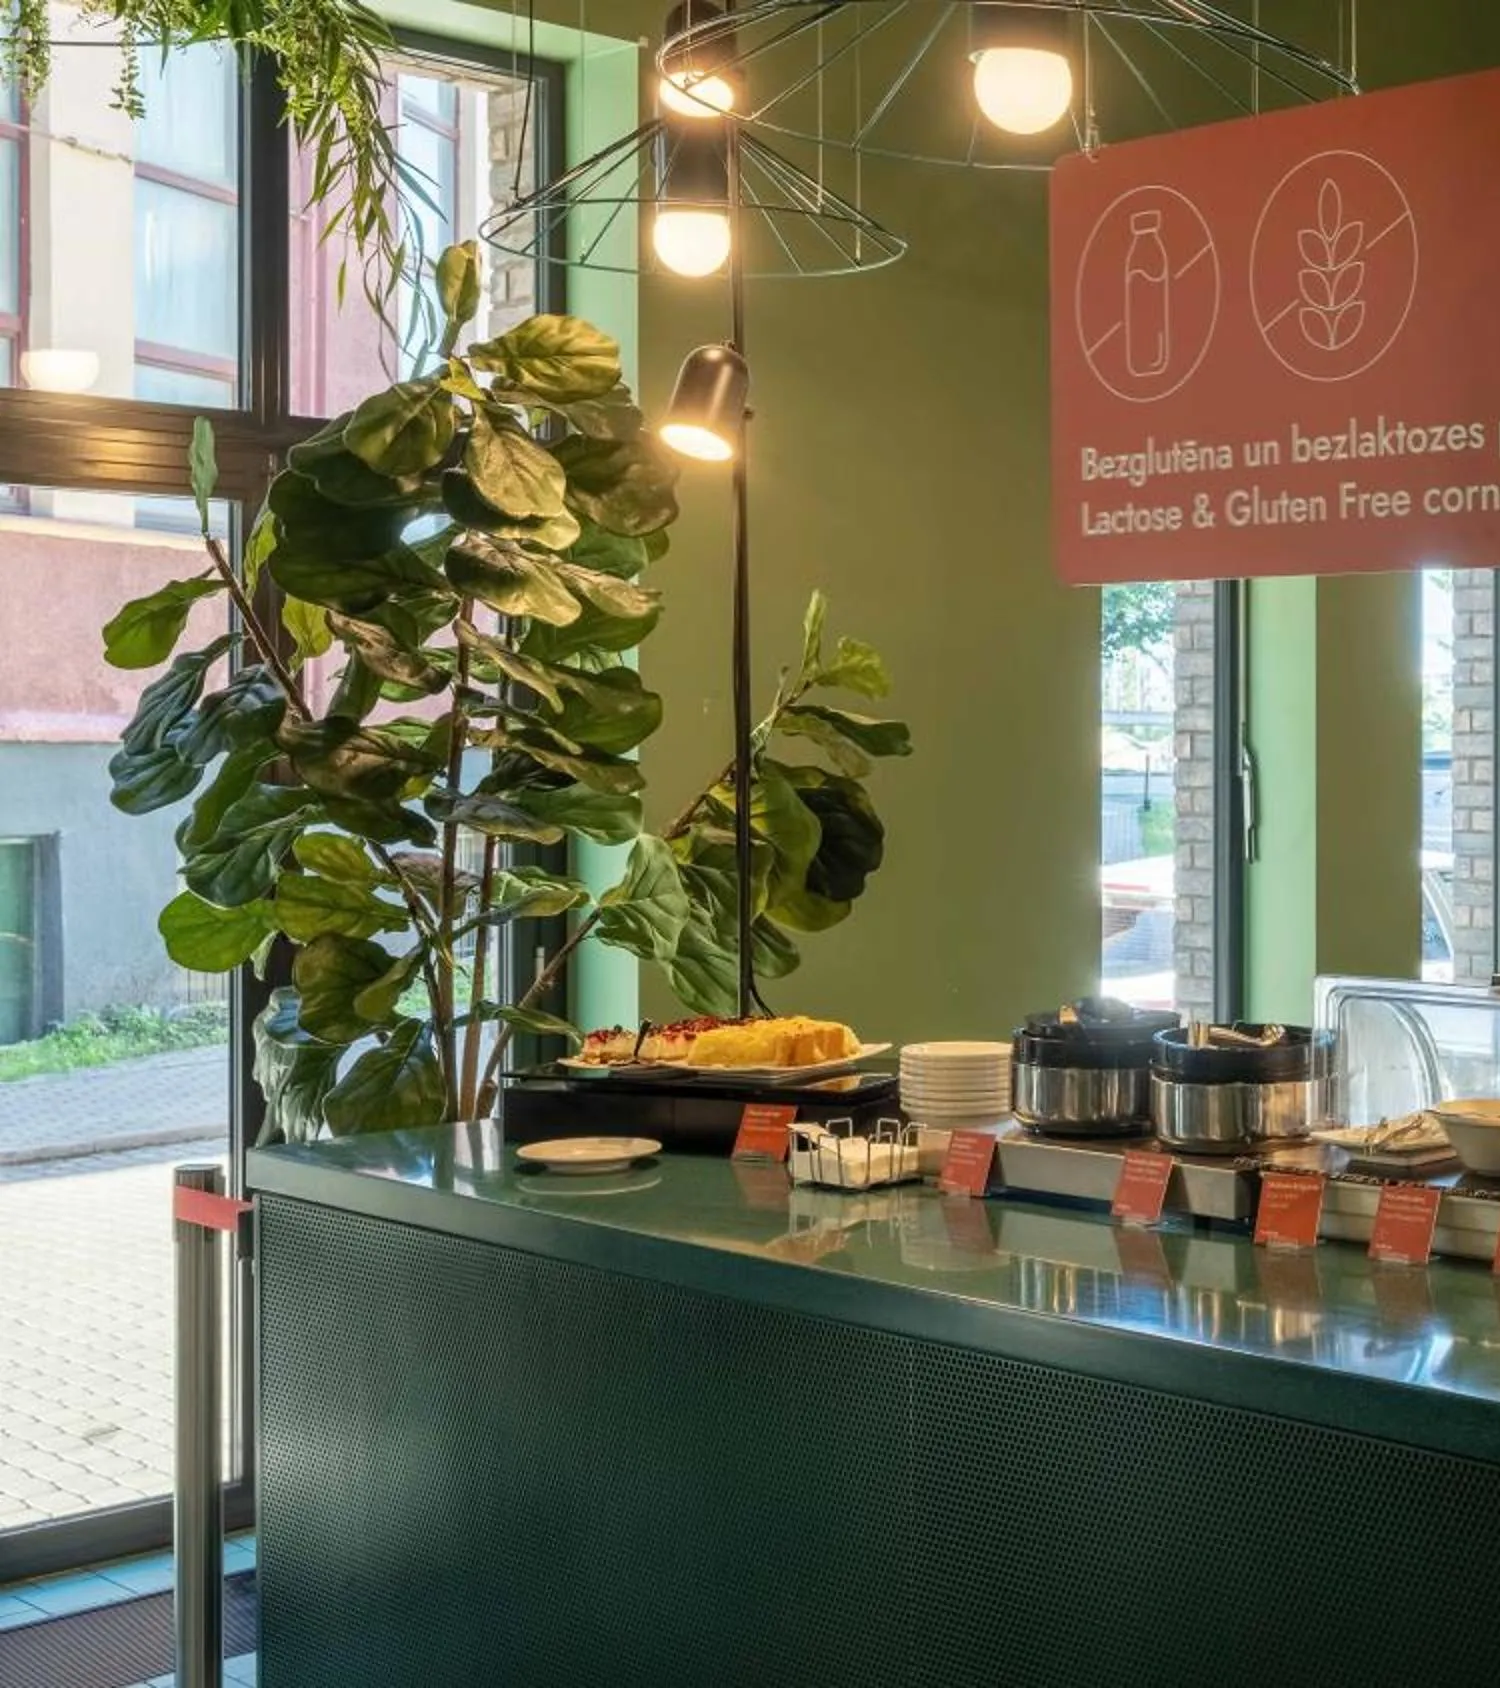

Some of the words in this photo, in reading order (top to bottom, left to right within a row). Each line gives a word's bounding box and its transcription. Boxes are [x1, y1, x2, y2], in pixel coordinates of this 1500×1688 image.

[1080, 437, 1234, 487] Bezglutēna
[1243, 440, 1281, 468] un
[1290, 414, 1486, 463] bezlaktozes
[1080, 500, 1184, 537] Lactose
[1191, 492, 1217, 529] &
[1225, 485, 1328, 527] Gluten
[1339, 481, 1412, 520] Free
